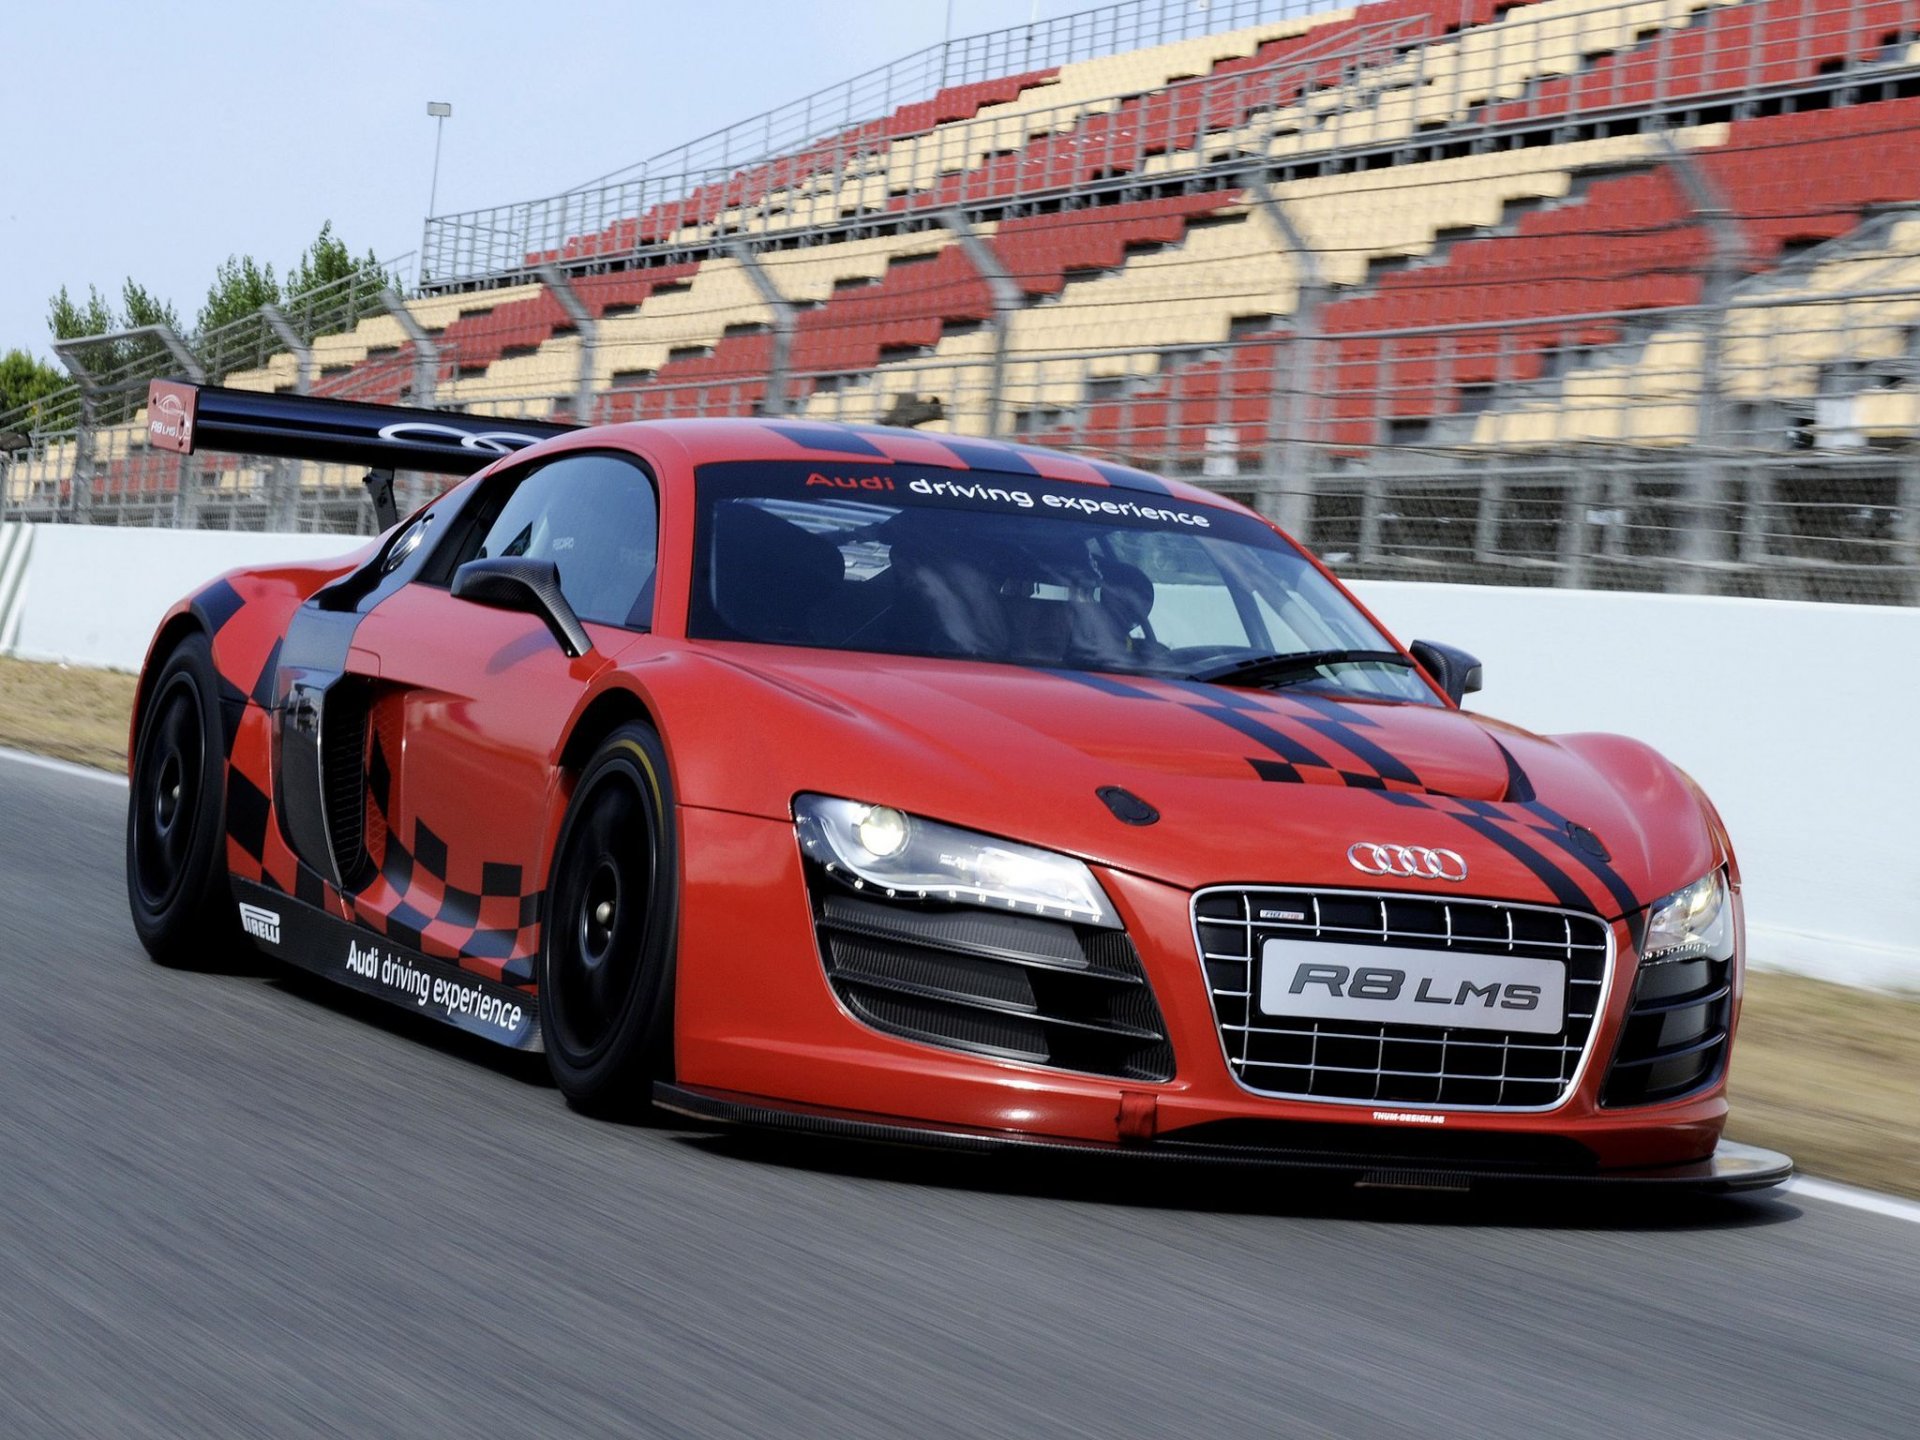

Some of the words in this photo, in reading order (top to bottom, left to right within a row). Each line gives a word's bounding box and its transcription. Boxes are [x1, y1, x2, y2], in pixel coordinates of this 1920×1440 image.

[806, 472, 894, 490] Audi
[908, 478, 1034, 508] driving
[1041, 491, 1210, 528] experience
[239, 902, 280, 944] PIRELLI
[346, 940, 379, 980] Audi
[381, 953, 430, 1007] driving
[433, 978, 522, 1031] experience
[1288, 963, 1405, 1001] R8
[1414, 978, 1541, 1010] LMS
